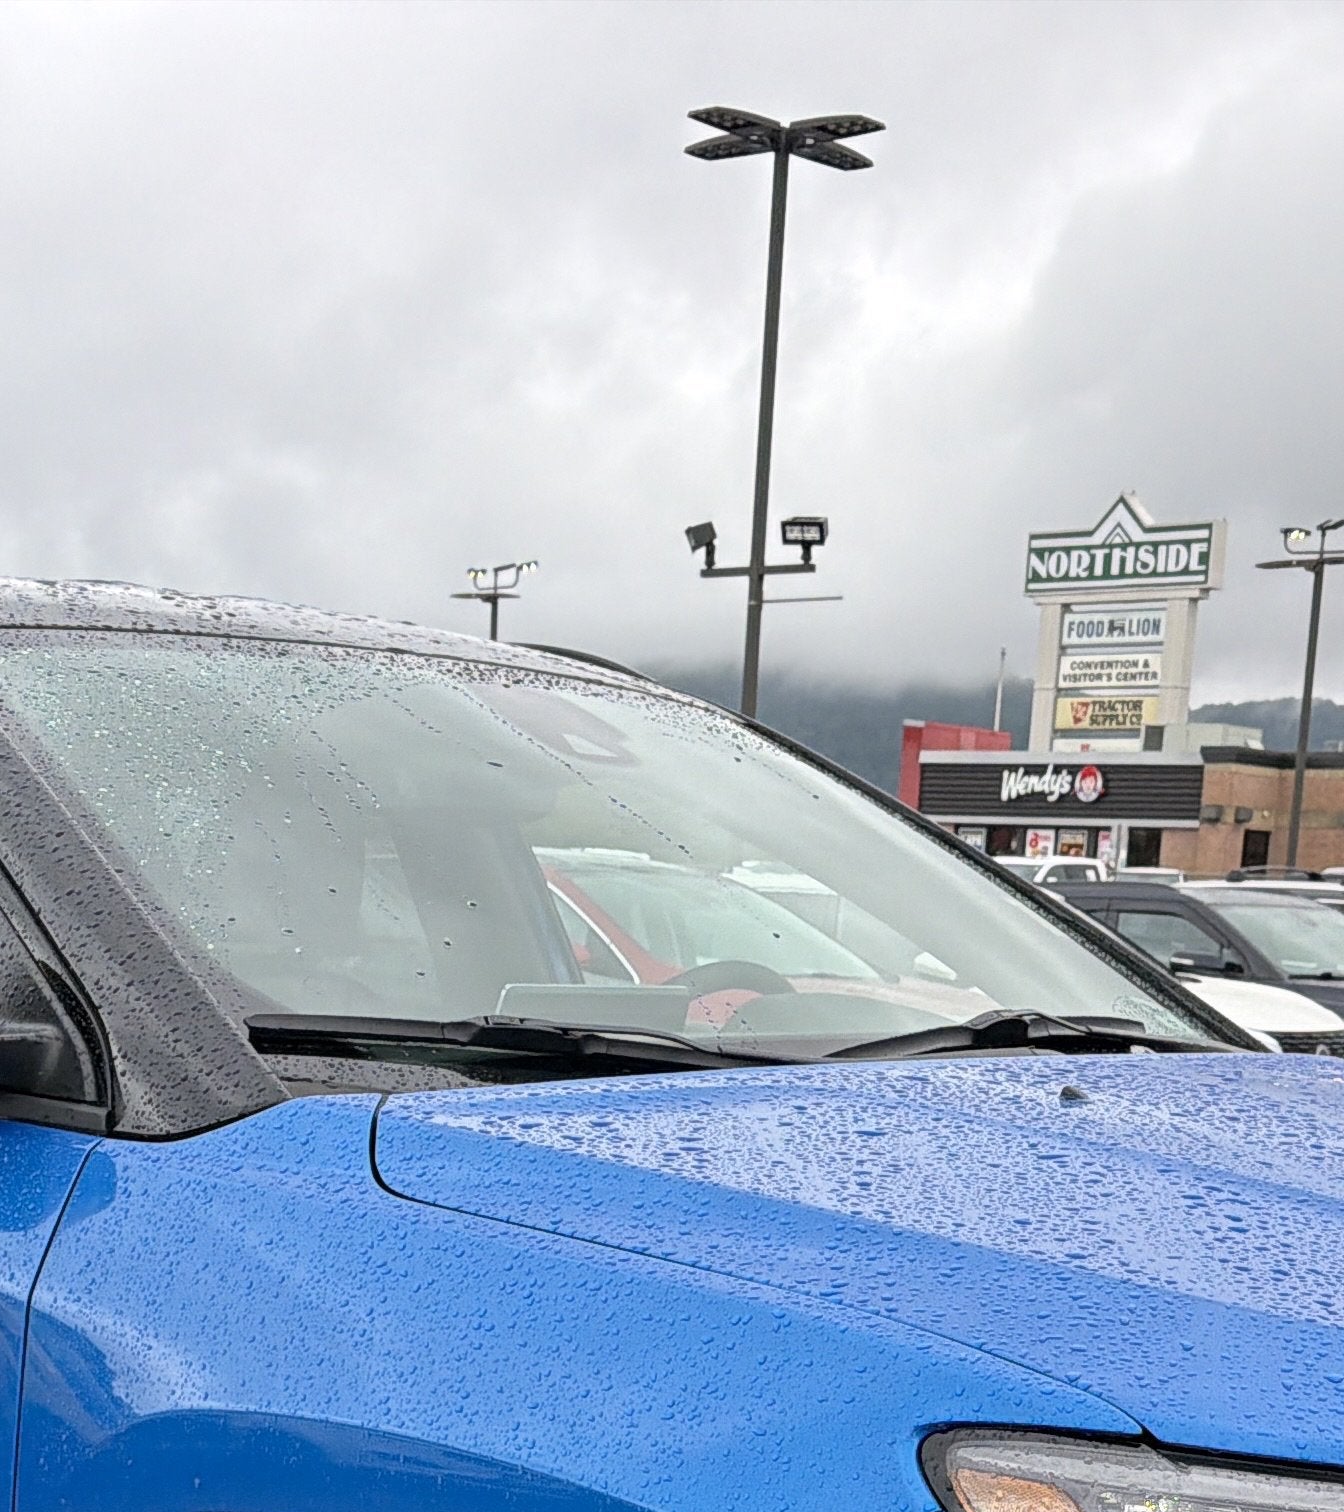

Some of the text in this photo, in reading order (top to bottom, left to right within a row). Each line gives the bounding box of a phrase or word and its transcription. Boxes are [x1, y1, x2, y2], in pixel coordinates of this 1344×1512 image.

[1029, 543, 1208, 579] NORTHSIDE
[1067, 618, 1161, 638] FOOD LION
[1070, 659, 1139, 671] CONVENTION
[1115, 670, 1158, 682] CENTER
[1091, 700, 1143, 713] TRACTOR
[1088, 713, 1128, 726] SUPPLY
[1000, 763, 1072, 802] Wendy's
